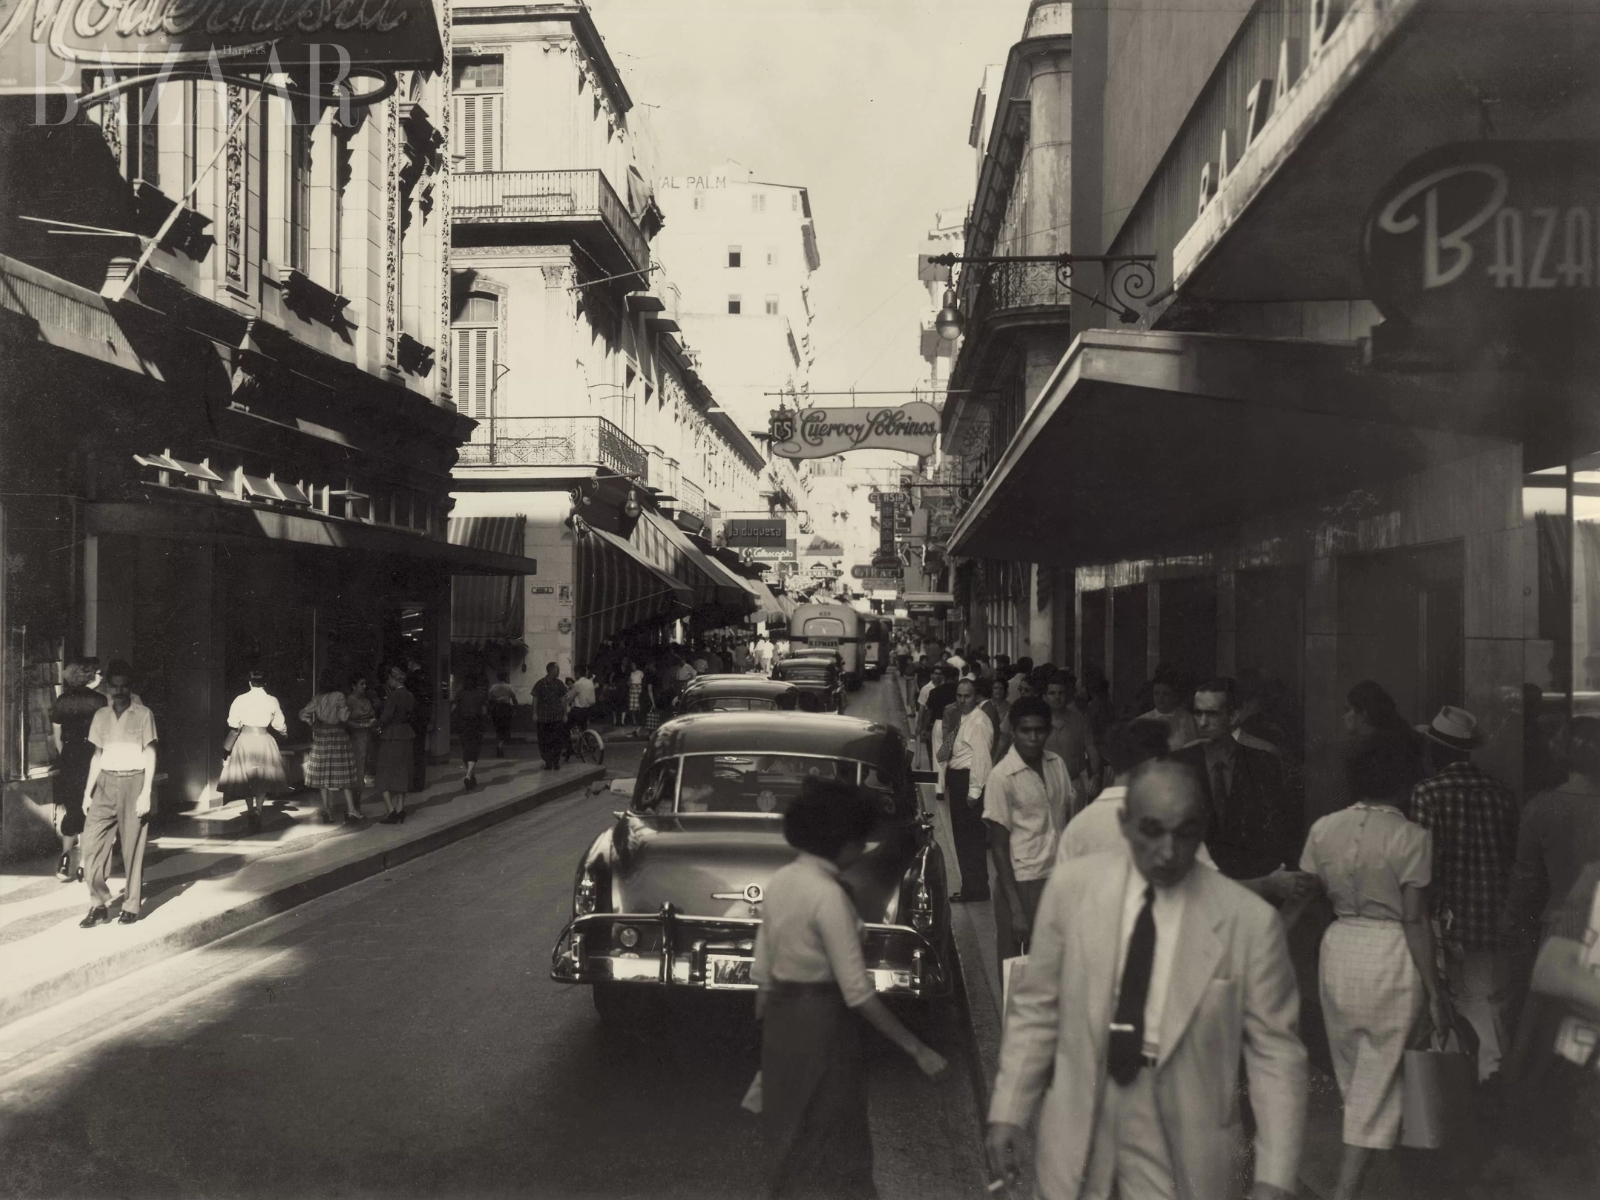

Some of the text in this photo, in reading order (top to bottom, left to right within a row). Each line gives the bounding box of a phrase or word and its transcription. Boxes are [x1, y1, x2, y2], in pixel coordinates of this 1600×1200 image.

[659, 175, 727, 189] AL PALM
[1379, 163, 1600, 289] BAZA
[800, 410, 857, 446] Cuervo
[857, 409, 937, 444] Sobrinos
[869, 493, 904, 502] EL ASIA
